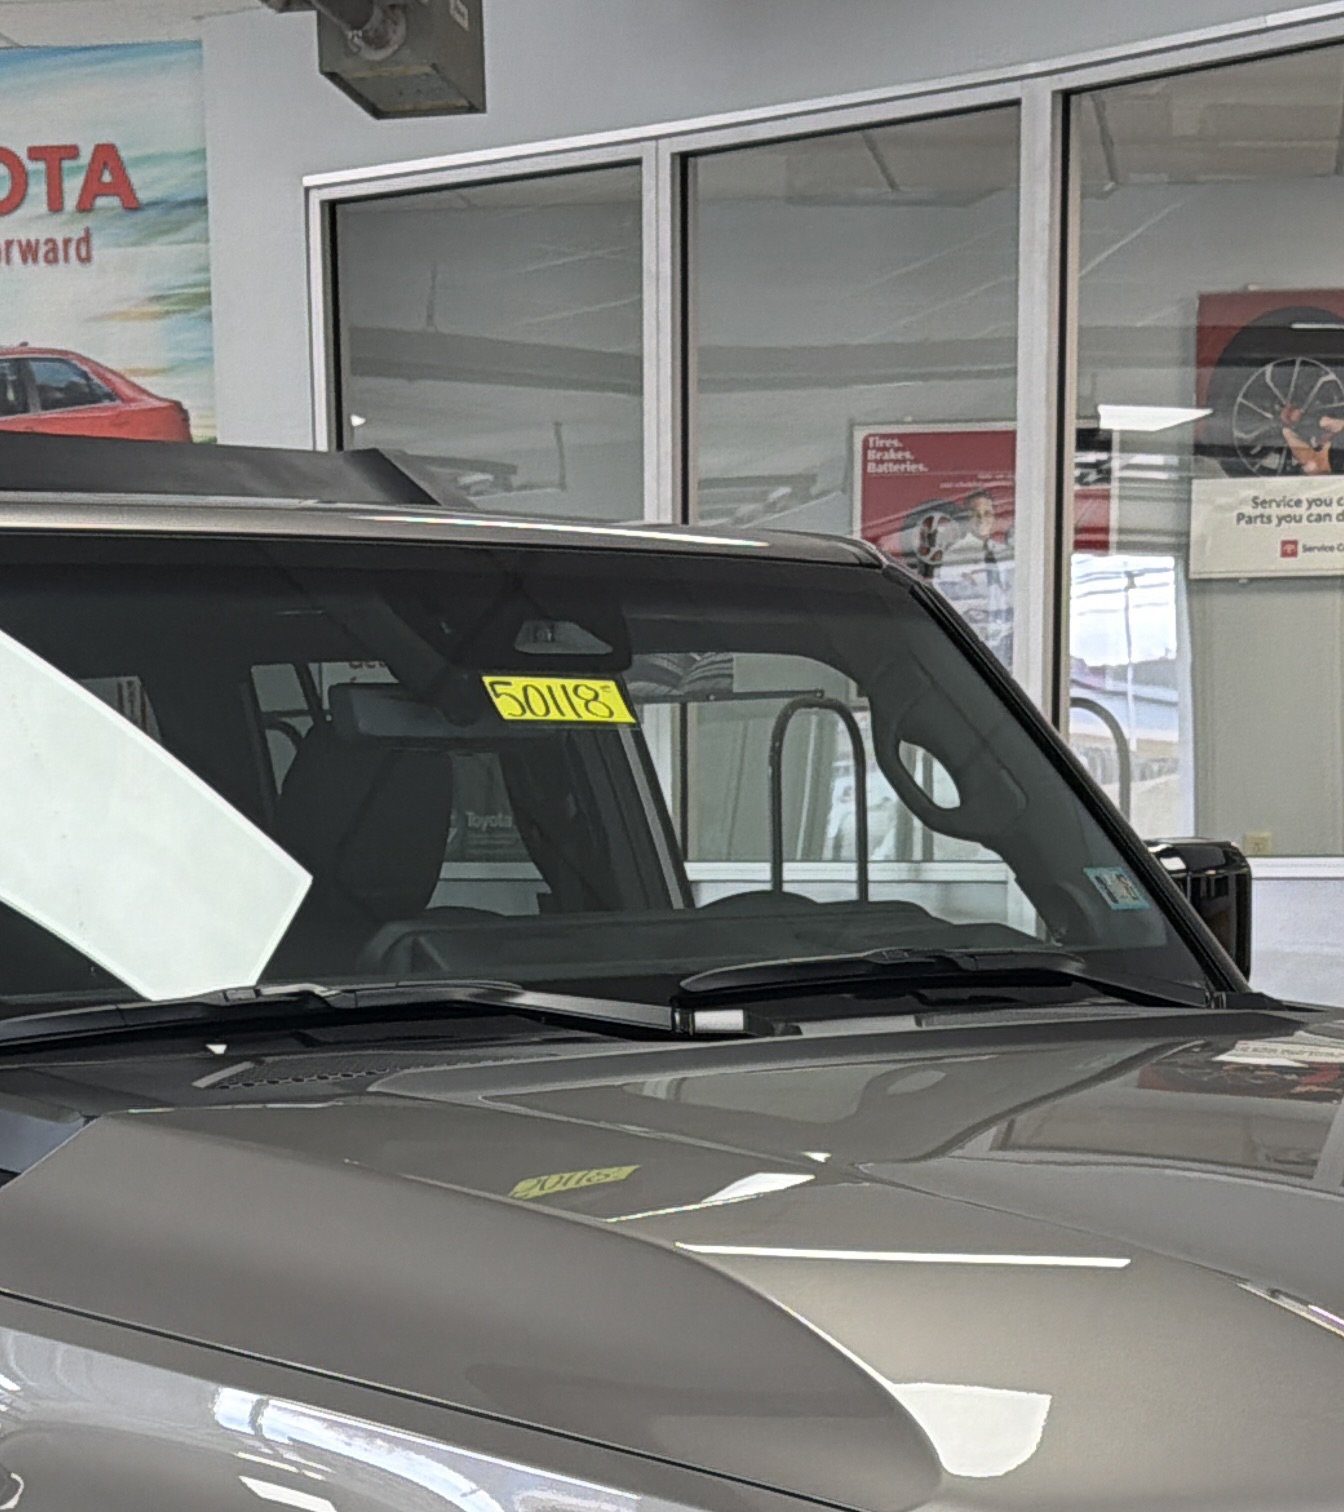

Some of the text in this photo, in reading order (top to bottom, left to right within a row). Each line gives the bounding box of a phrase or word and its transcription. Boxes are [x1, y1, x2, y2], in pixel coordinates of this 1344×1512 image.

[868, 436, 904, 448] Tires.
[867, 449, 914, 461] Brakes.
[866, 461, 929, 474] Batteries.
[1251, 495, 1303, 509] Service
[1306, 496, 1333, 510] you
[1236, 512, 1272, 526] Parts
[1275, 513, 1302, 527] you
[1306, 512, 1332, 523] can
[1302, 543, 1335, 553] Service
[489, 681, 614, 718] 50118
